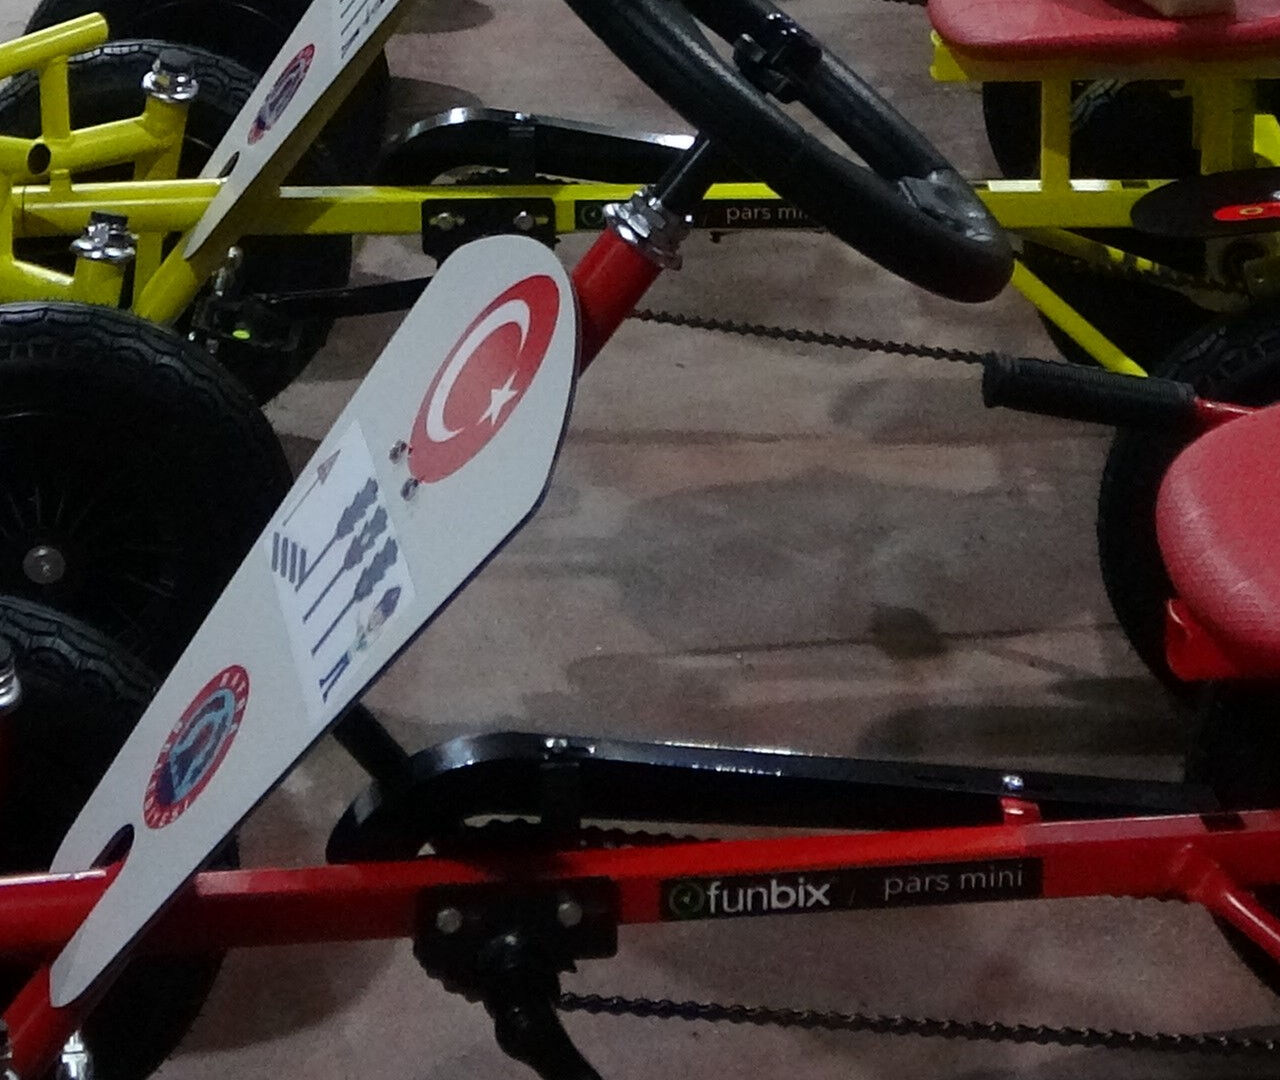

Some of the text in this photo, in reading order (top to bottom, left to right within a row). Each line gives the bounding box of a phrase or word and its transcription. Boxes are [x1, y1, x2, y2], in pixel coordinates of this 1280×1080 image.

[726, 204, 772, 222] pars
[706, 863, 1024, 914] funbix pars mini
